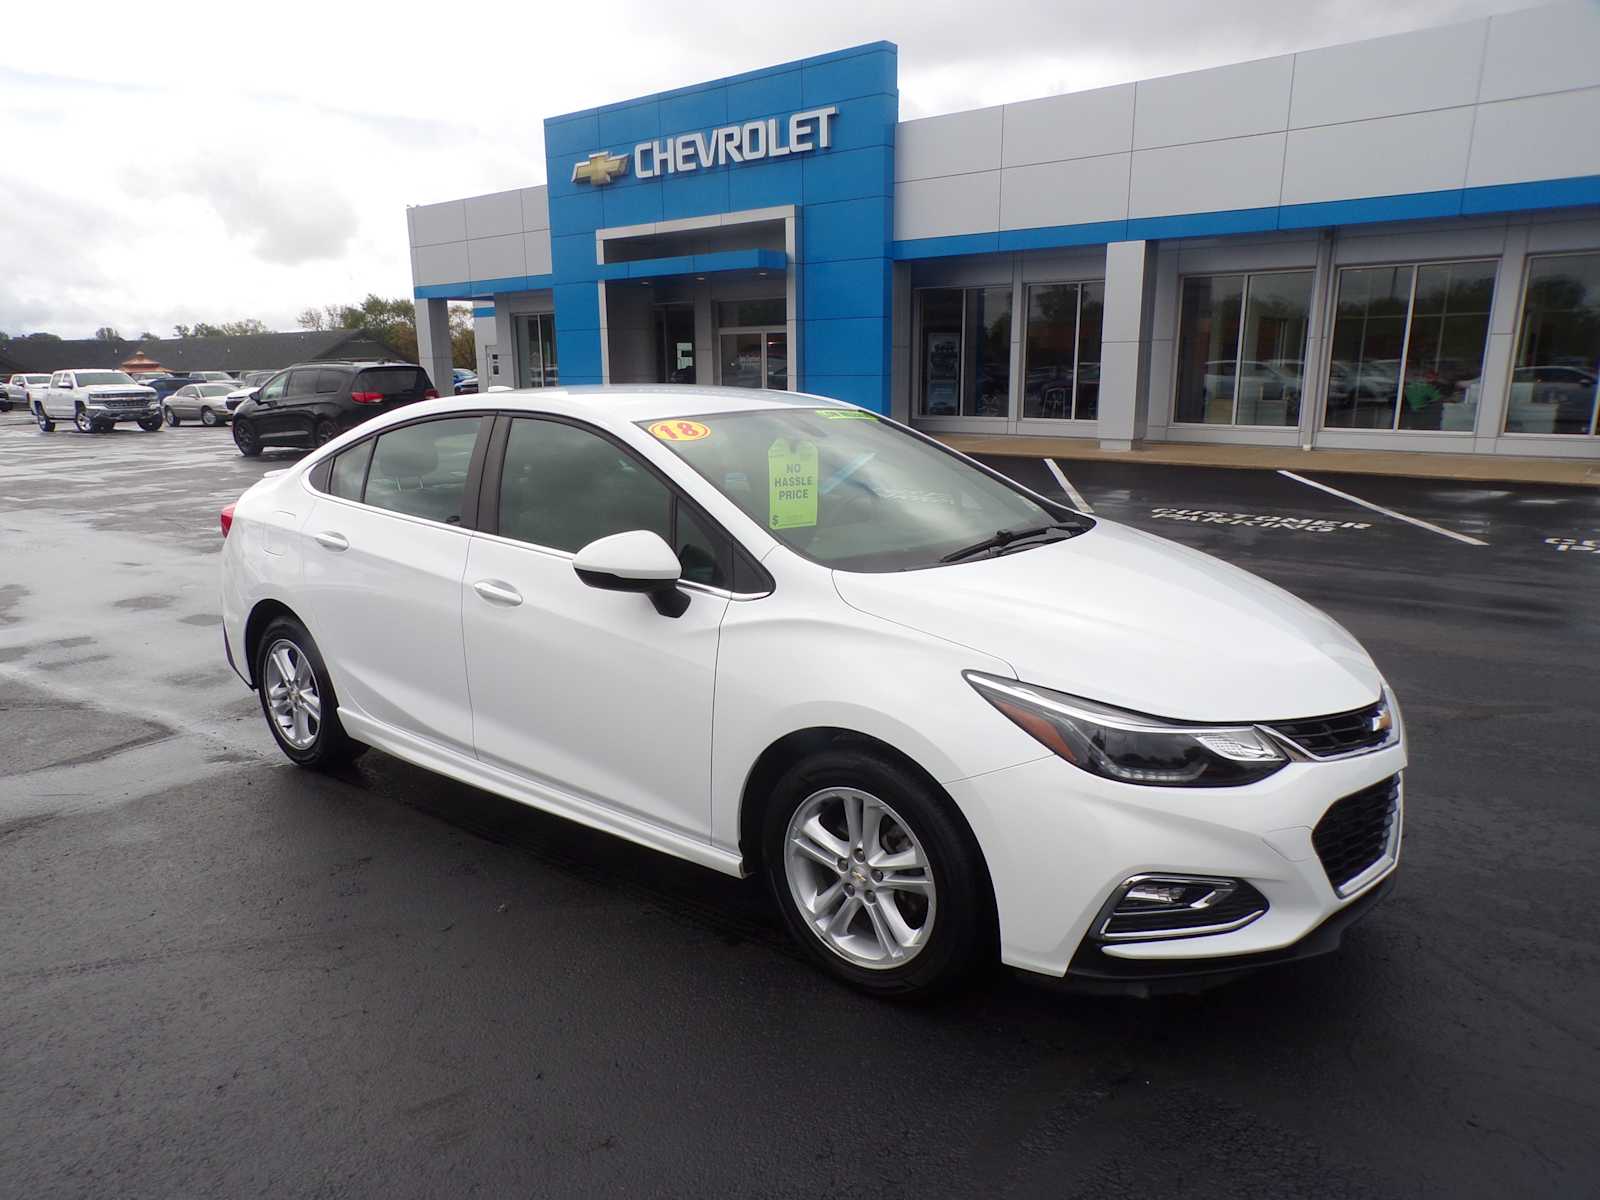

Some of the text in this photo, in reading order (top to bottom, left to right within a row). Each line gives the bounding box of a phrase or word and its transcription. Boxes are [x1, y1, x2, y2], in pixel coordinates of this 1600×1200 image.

[634, 105, 838, 179] CHEVROLET
[660, 422, 699, 439] 18
[786, 463, 801, 473] NO
[774, 476, 813, 488] HASSLE
[779, 488, 809, 500] PRICE
